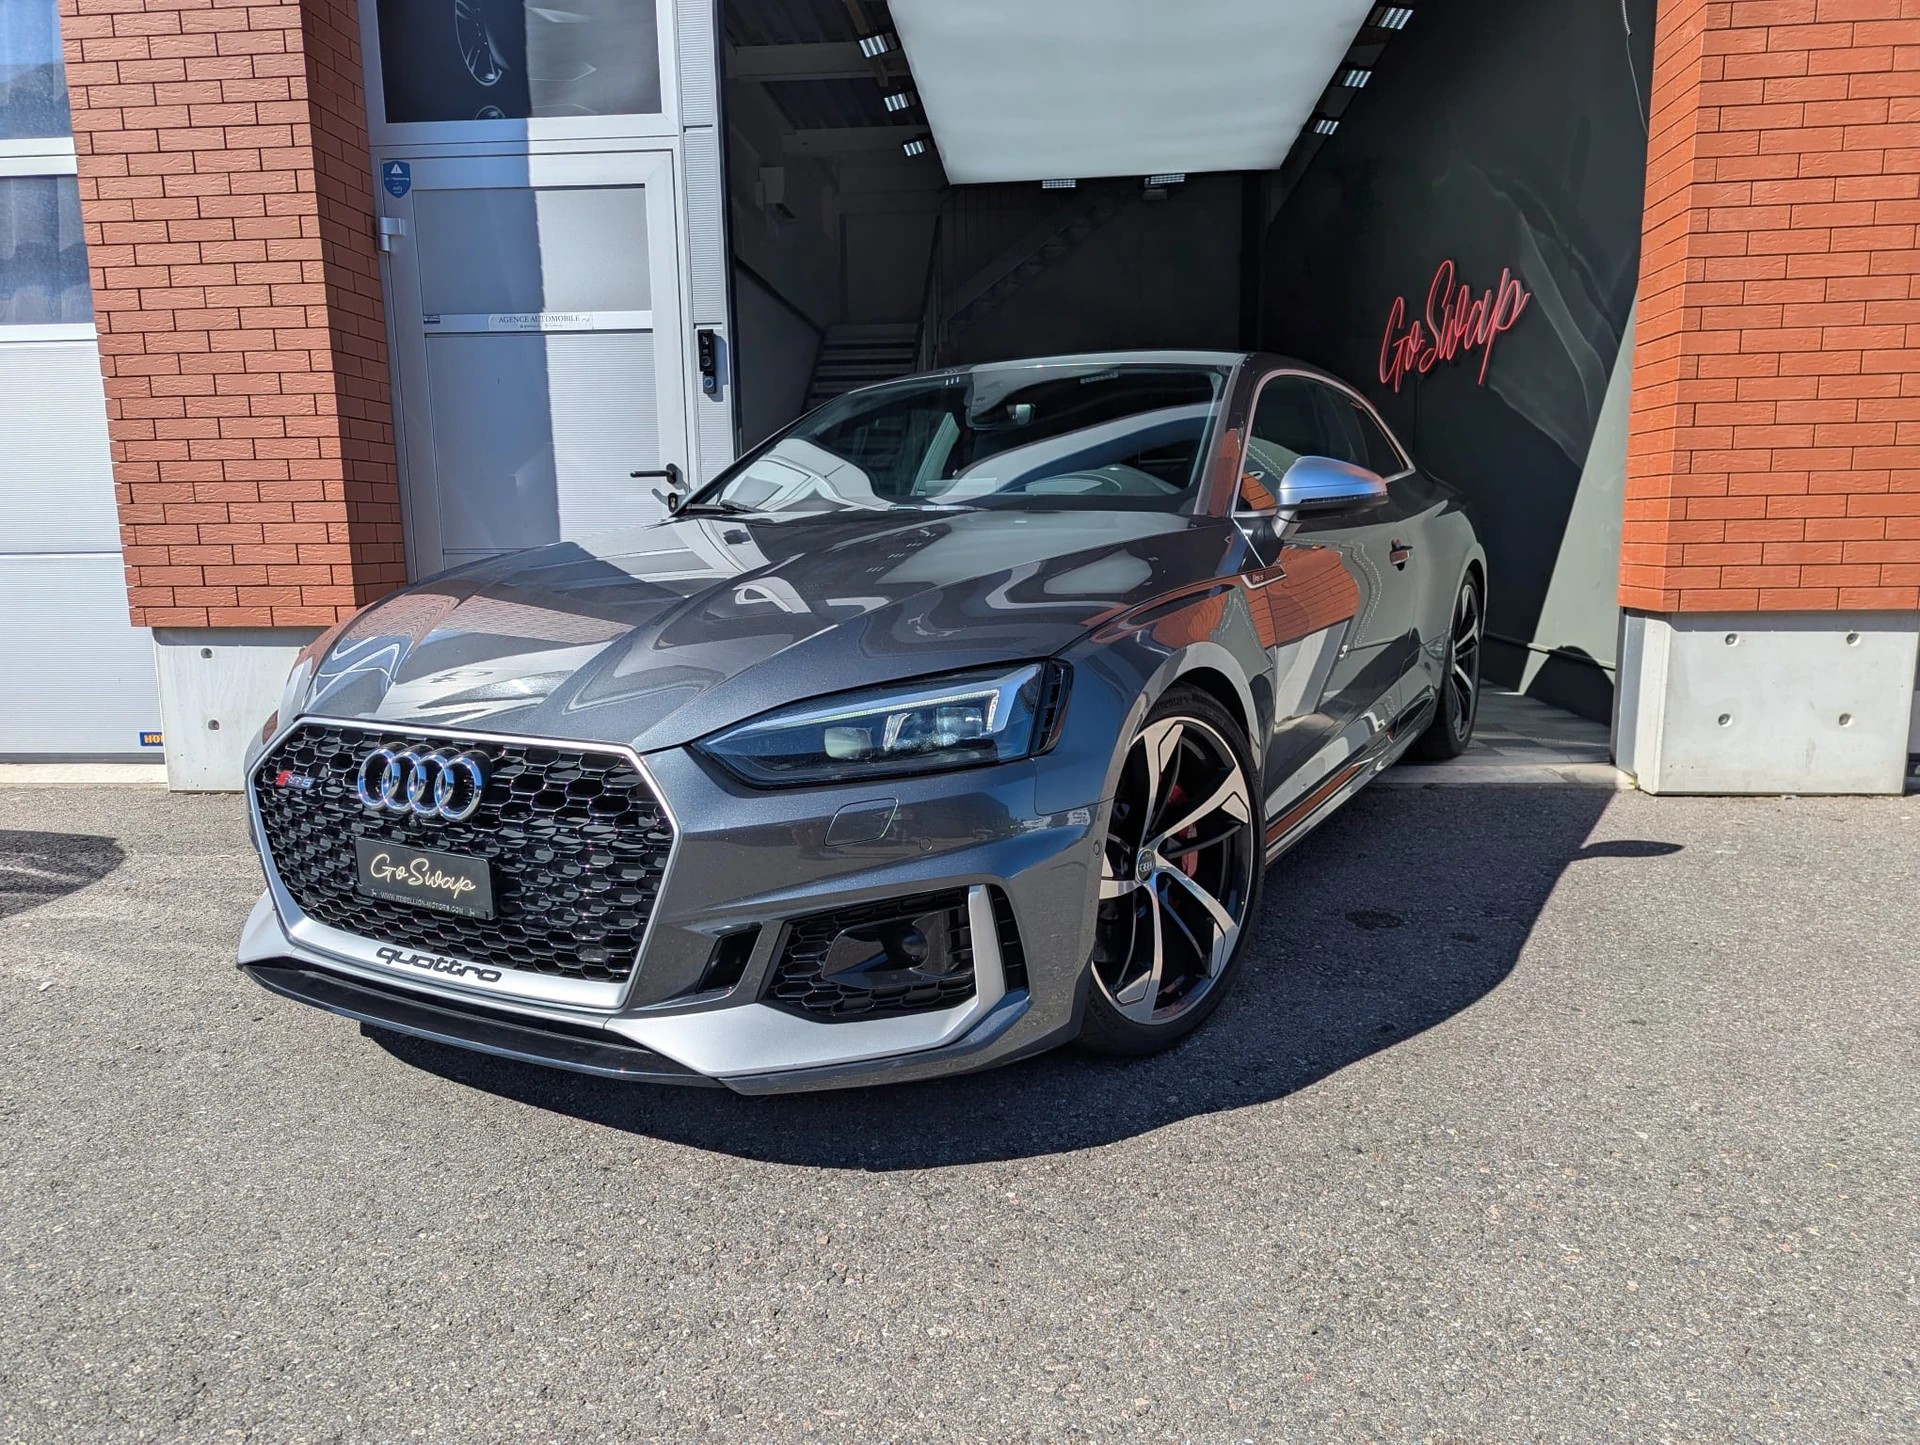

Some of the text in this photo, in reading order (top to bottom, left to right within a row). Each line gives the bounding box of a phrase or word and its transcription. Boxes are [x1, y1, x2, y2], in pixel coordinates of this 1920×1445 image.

[498, 315, 530, 323] AGENCE
[530, 314, 580, 323] AUTOMOBILE
[376, 946, 502, 982] quattro
